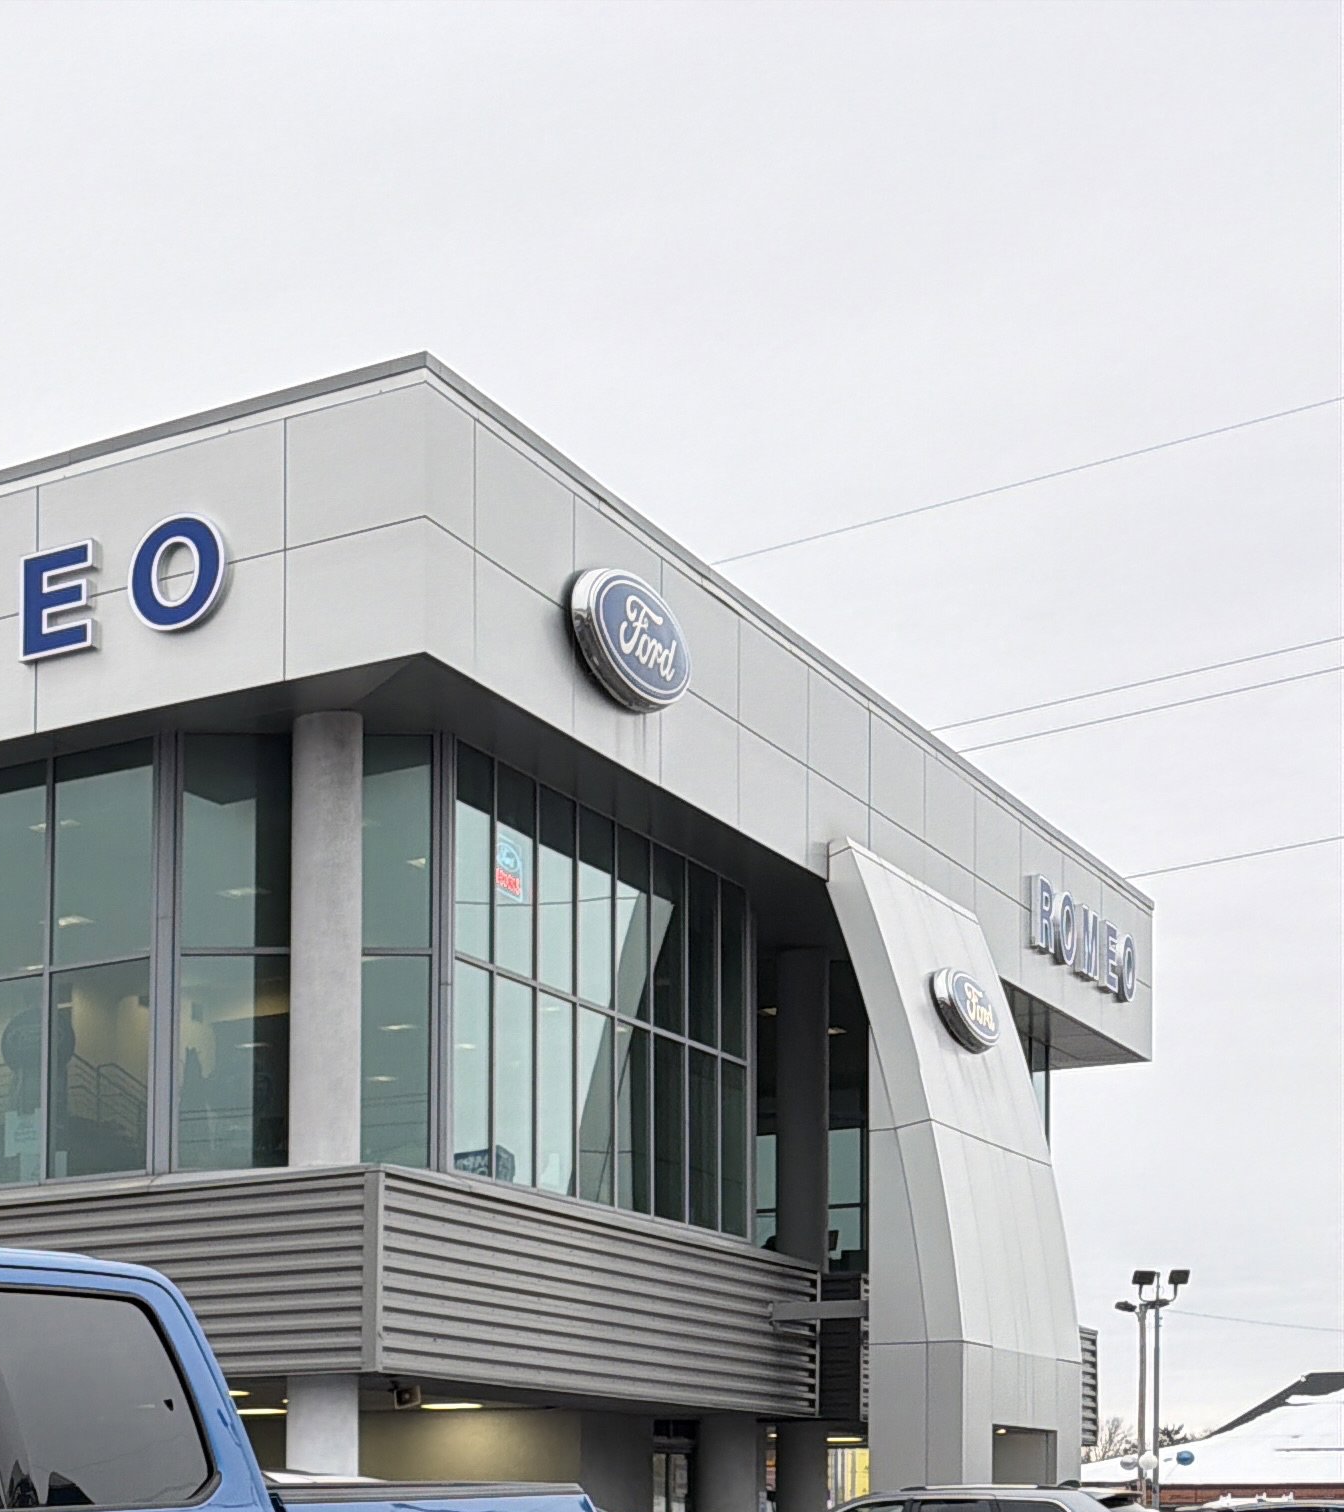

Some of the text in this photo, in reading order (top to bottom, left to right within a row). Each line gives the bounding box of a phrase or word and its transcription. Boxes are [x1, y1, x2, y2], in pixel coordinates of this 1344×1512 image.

[619, 594, 677, 682] Ford
[1032, 874, 1137, 1002] ROMEO
[964, 981, 996, 1031] Ford
